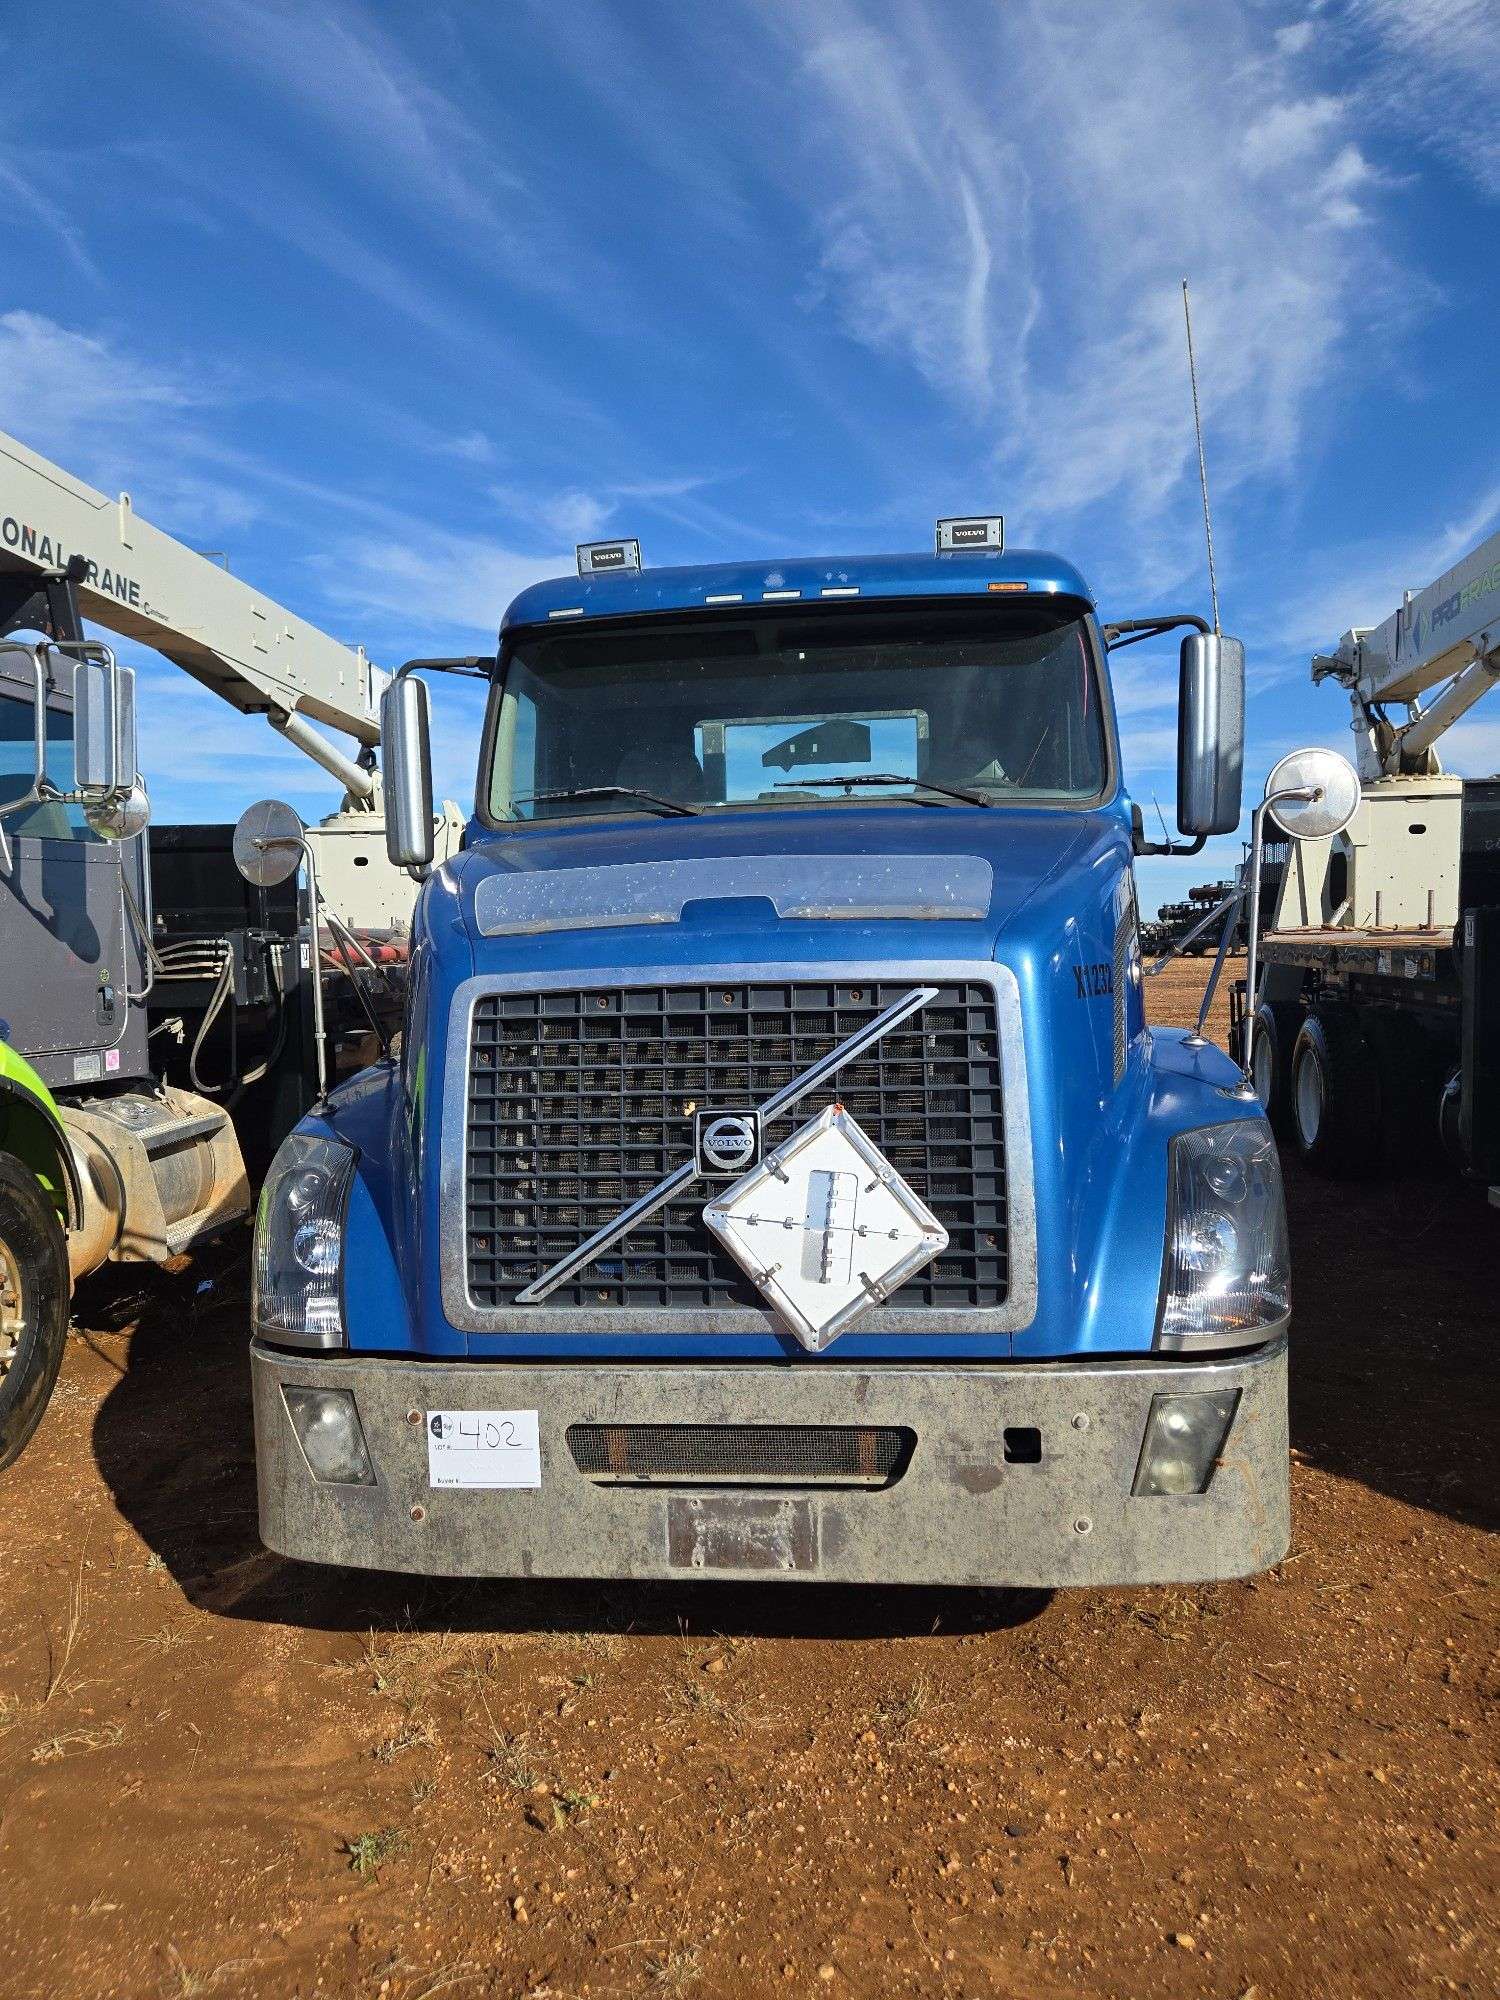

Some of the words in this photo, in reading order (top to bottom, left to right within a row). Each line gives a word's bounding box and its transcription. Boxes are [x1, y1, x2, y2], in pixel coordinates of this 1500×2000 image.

[955, 529, 985, 537] VOLVO
[593, 552, 622, 561] VOLVO
[85, 558, 141, 607] RANE
[705, 1139, 752, 1147] VOLVO
[459, 1418, 523, 1450] 402
